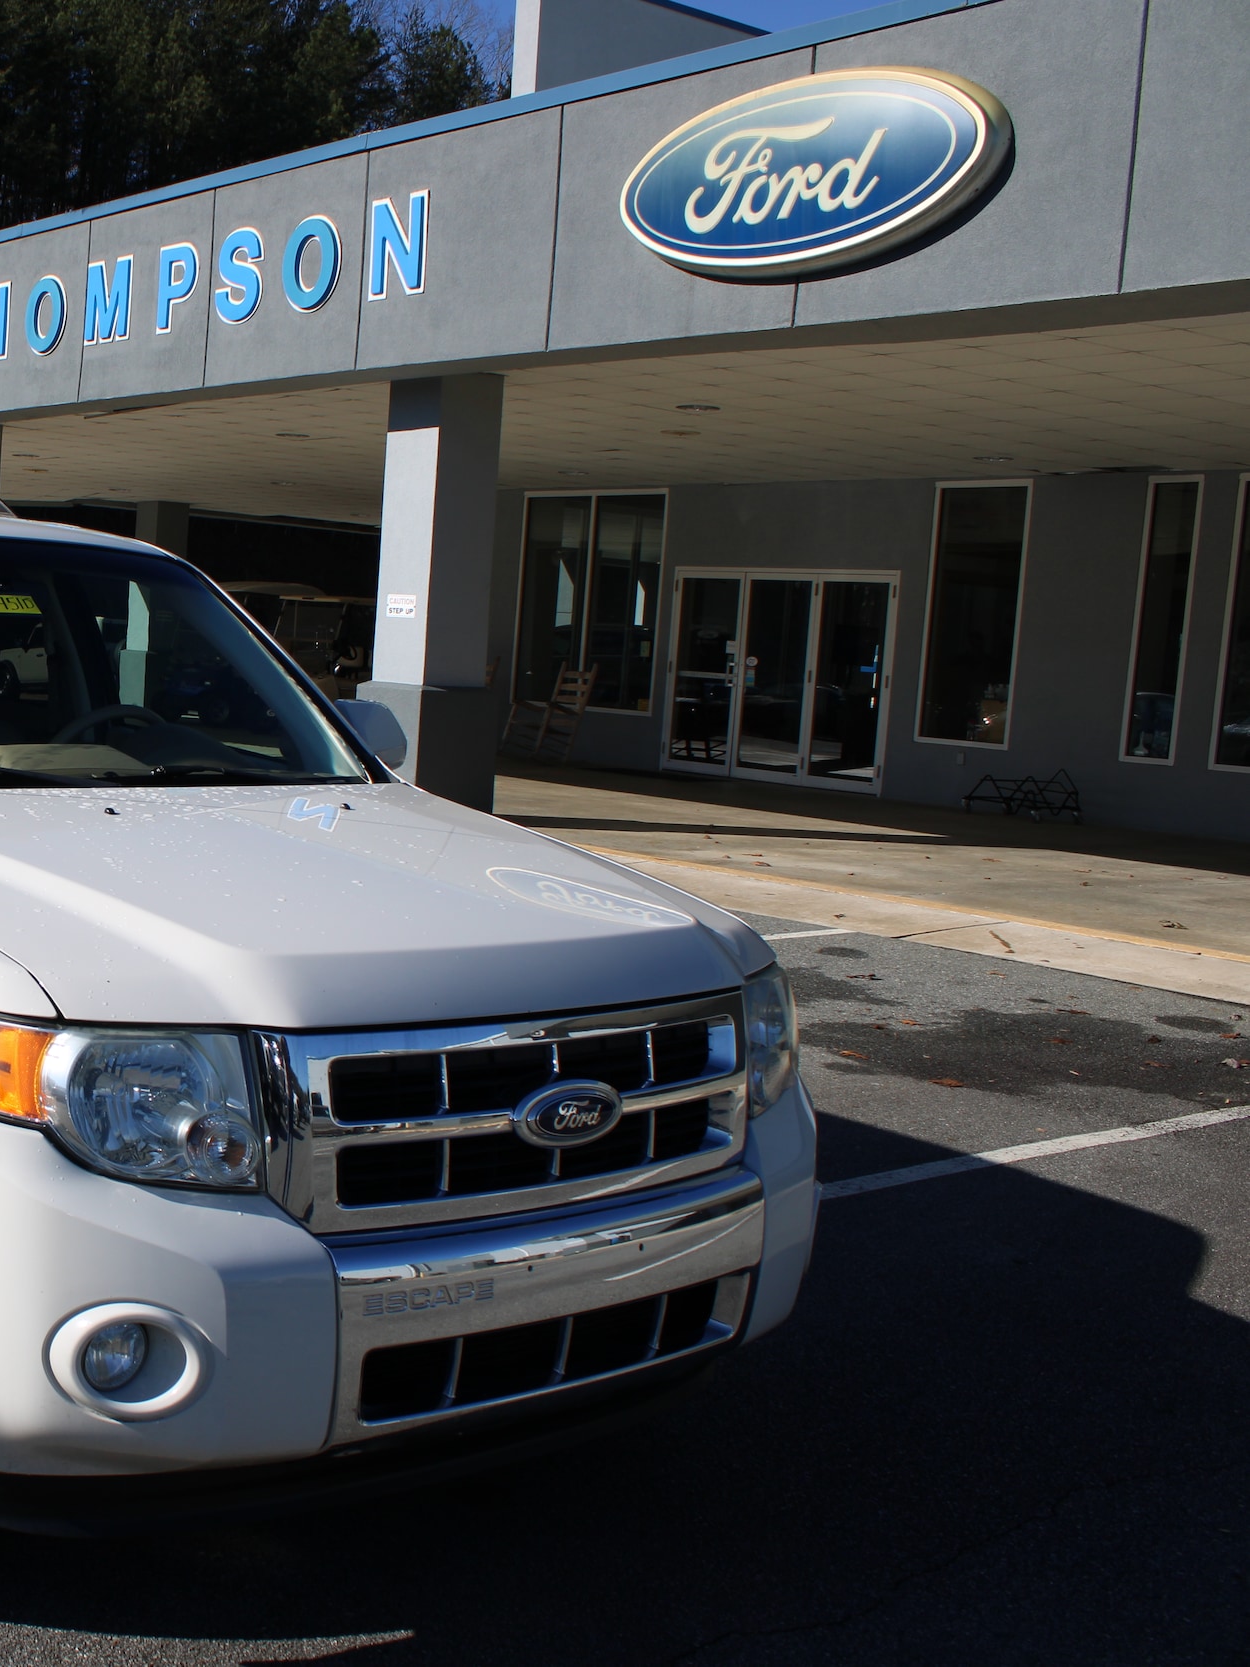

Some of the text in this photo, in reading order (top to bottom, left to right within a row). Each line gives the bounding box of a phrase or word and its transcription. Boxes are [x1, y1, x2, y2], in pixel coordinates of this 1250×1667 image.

[684, 116, 889, 234] Ford
[389, 597, 415, 605] CAUTION
[554, 1100, 602, 1130] Ford
[362, 1278, 494, 1316] ESCAPE
